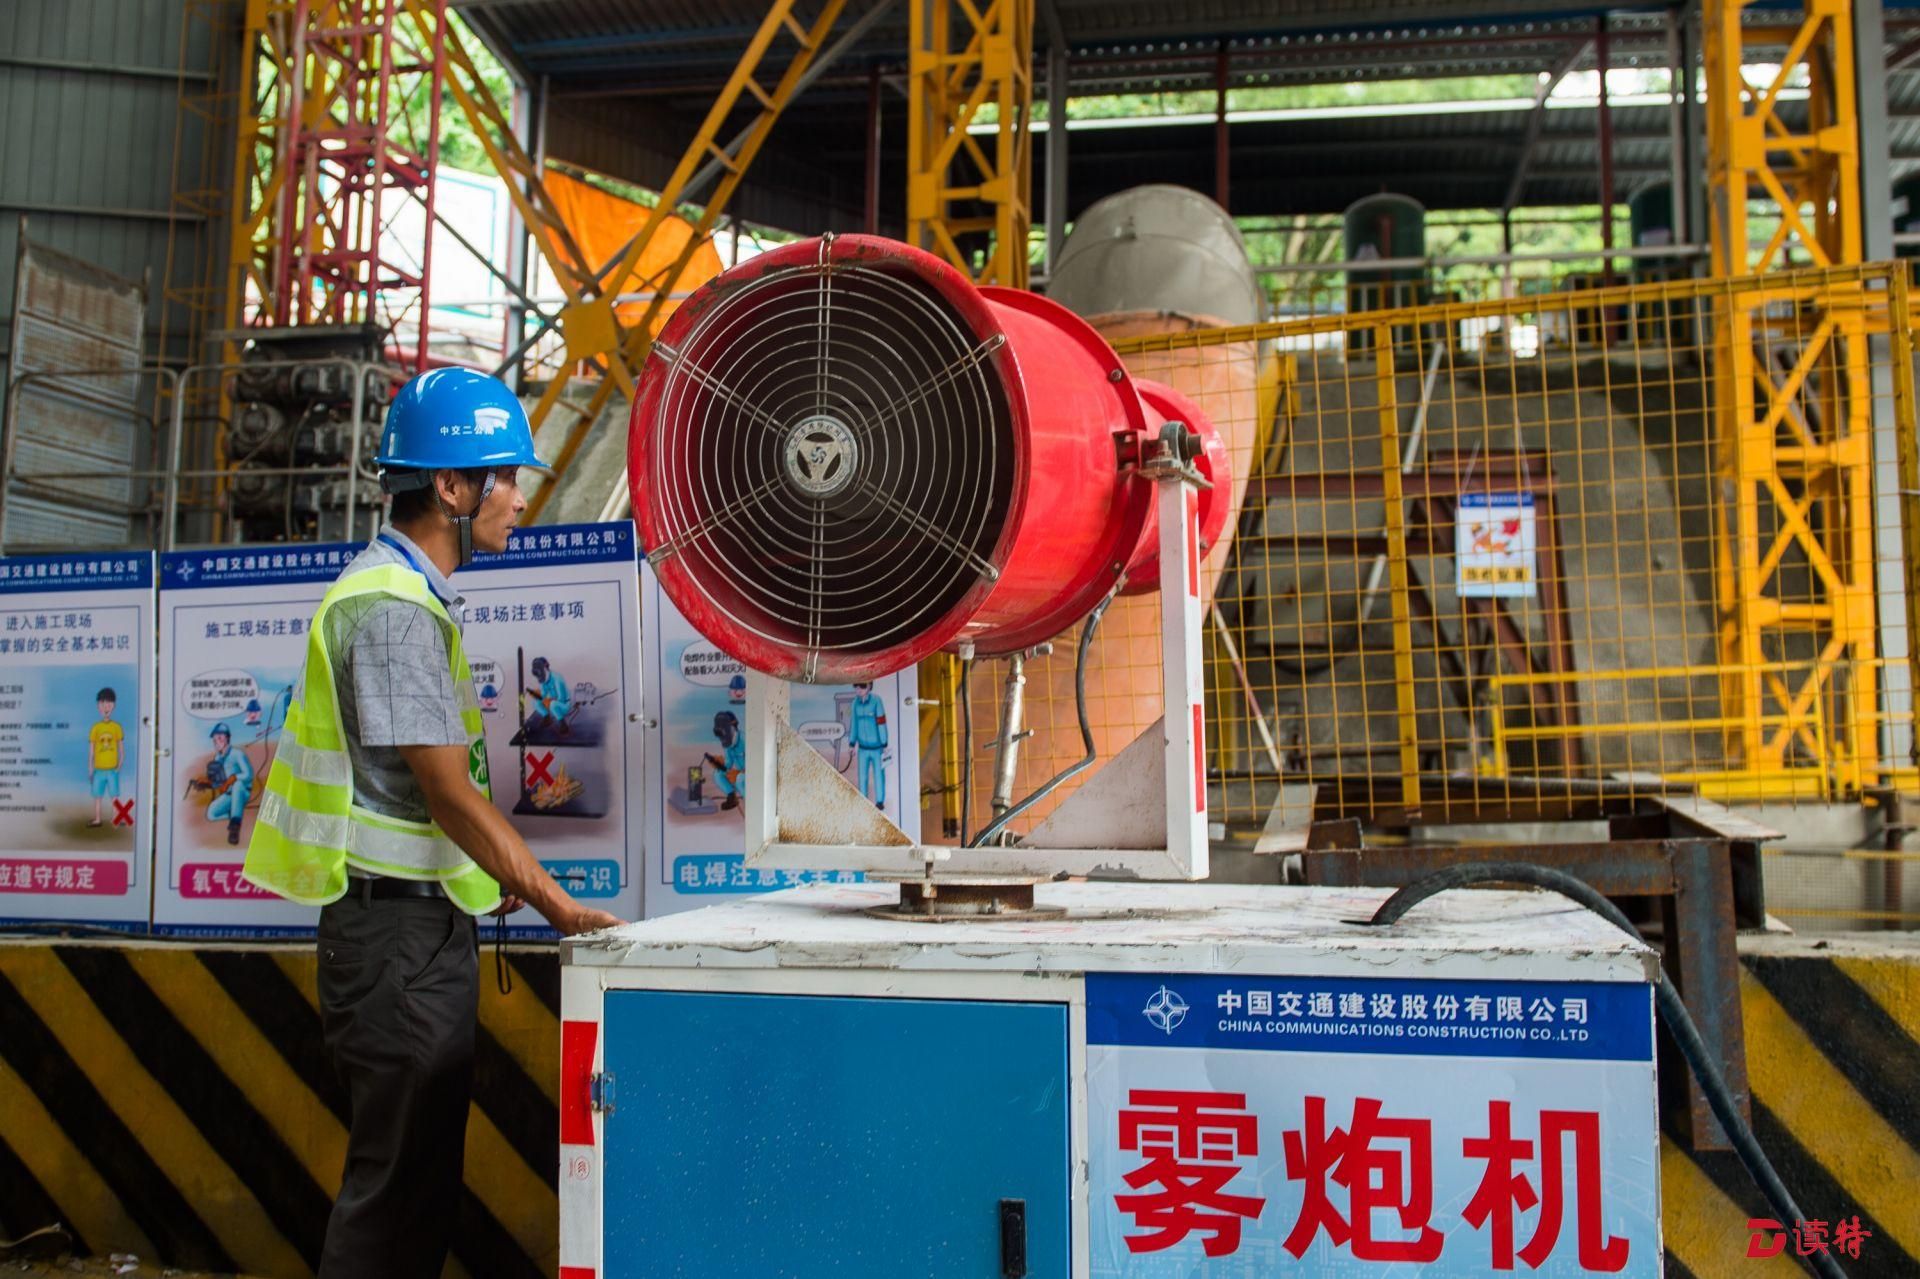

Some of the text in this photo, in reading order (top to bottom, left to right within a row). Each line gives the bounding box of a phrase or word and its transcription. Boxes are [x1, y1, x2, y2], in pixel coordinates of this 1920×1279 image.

[6, 613, 92, 631] 进入施工现场
[0, 863, 95, 889] 应遵守规定
[1217, 989, 1588, 1024] 中国交通建设股份有限公司
[1218, 1019, 1263, 1035] CHINA
[1266, 1021, 1404, 1038] COMMUNICATIONS
[1407, 1024, 1527, 1040] CONSTRUCTION
[1114, 1089, 1630, 1273] 雾炮机
